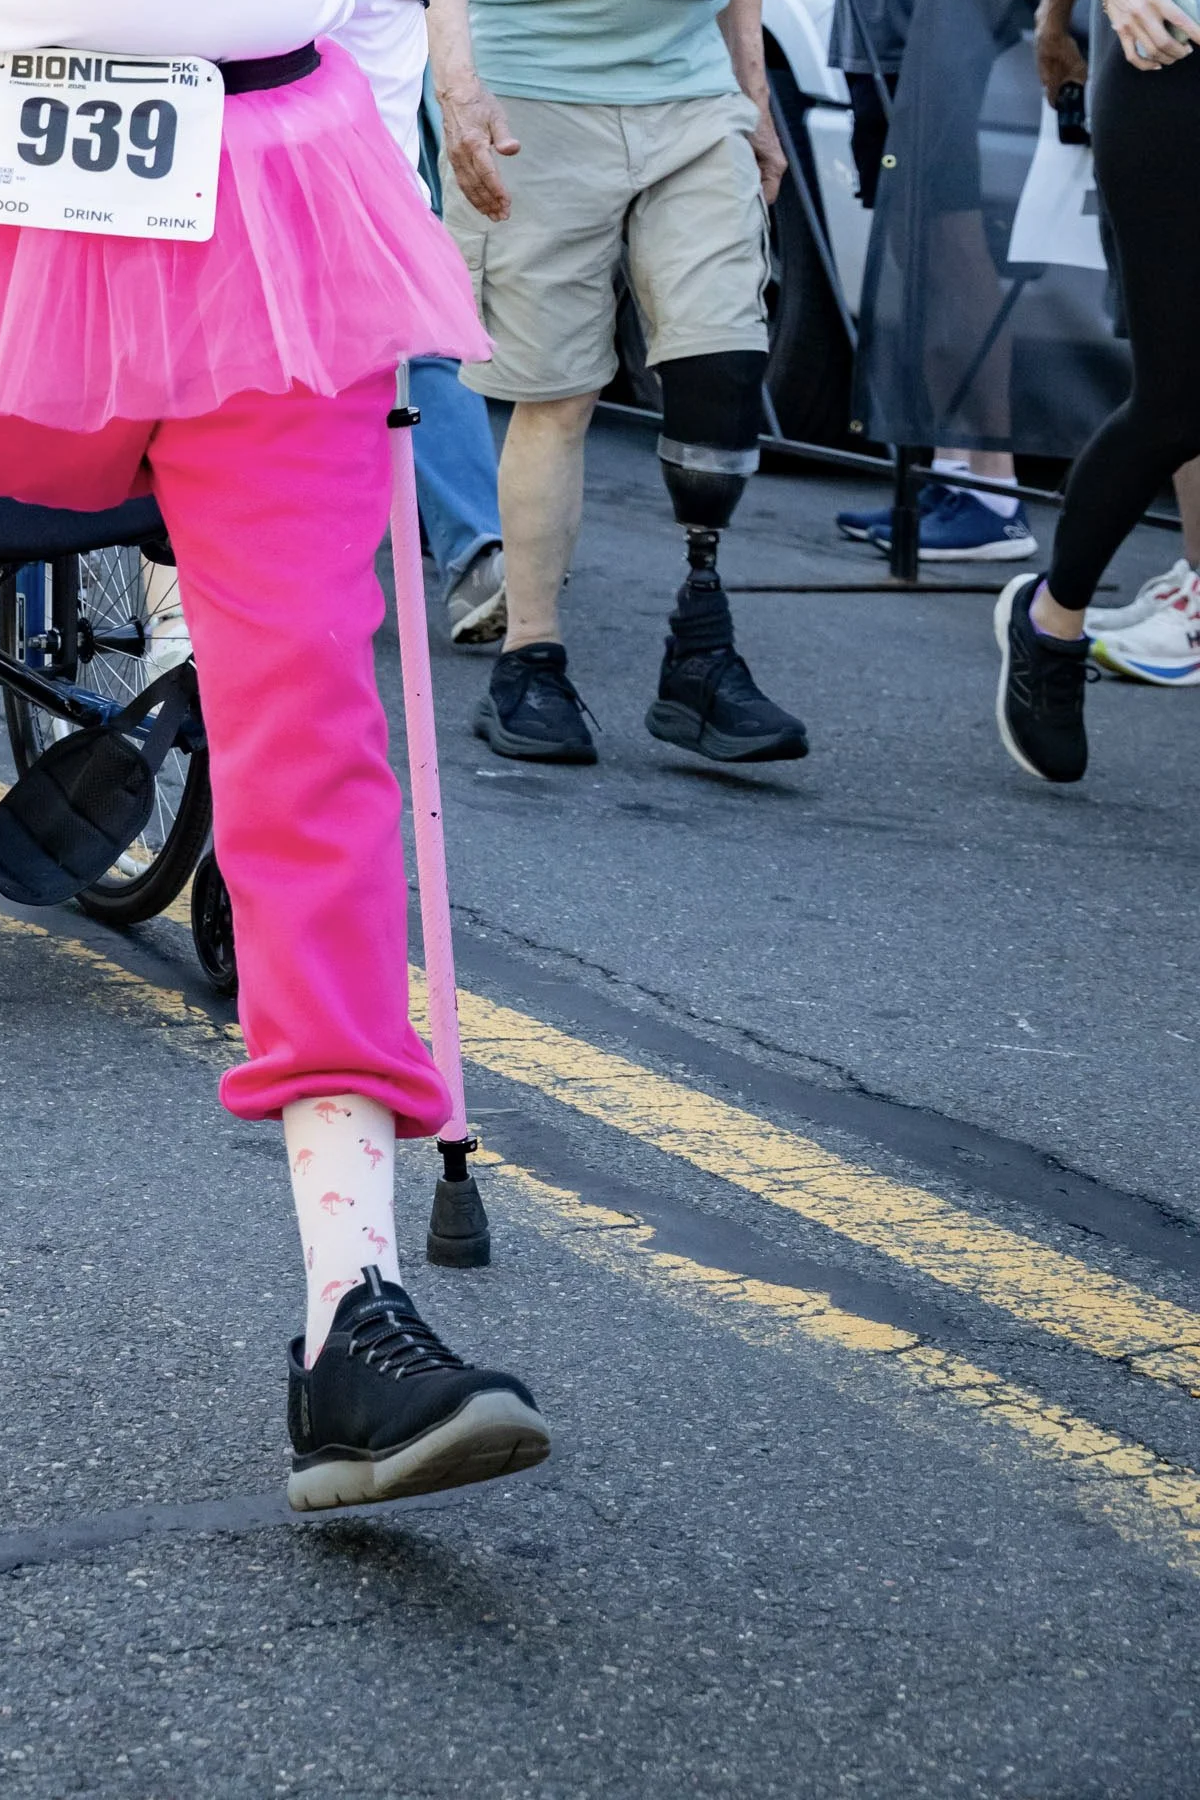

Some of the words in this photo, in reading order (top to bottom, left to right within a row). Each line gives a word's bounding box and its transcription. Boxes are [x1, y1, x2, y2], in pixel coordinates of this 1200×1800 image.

[11, 55, 170, 84] BIONIC
[17, 96, 178, 180] 939
[64, 207, 114, 222] DRINK
[147, 216, 198, 229] DRINK
